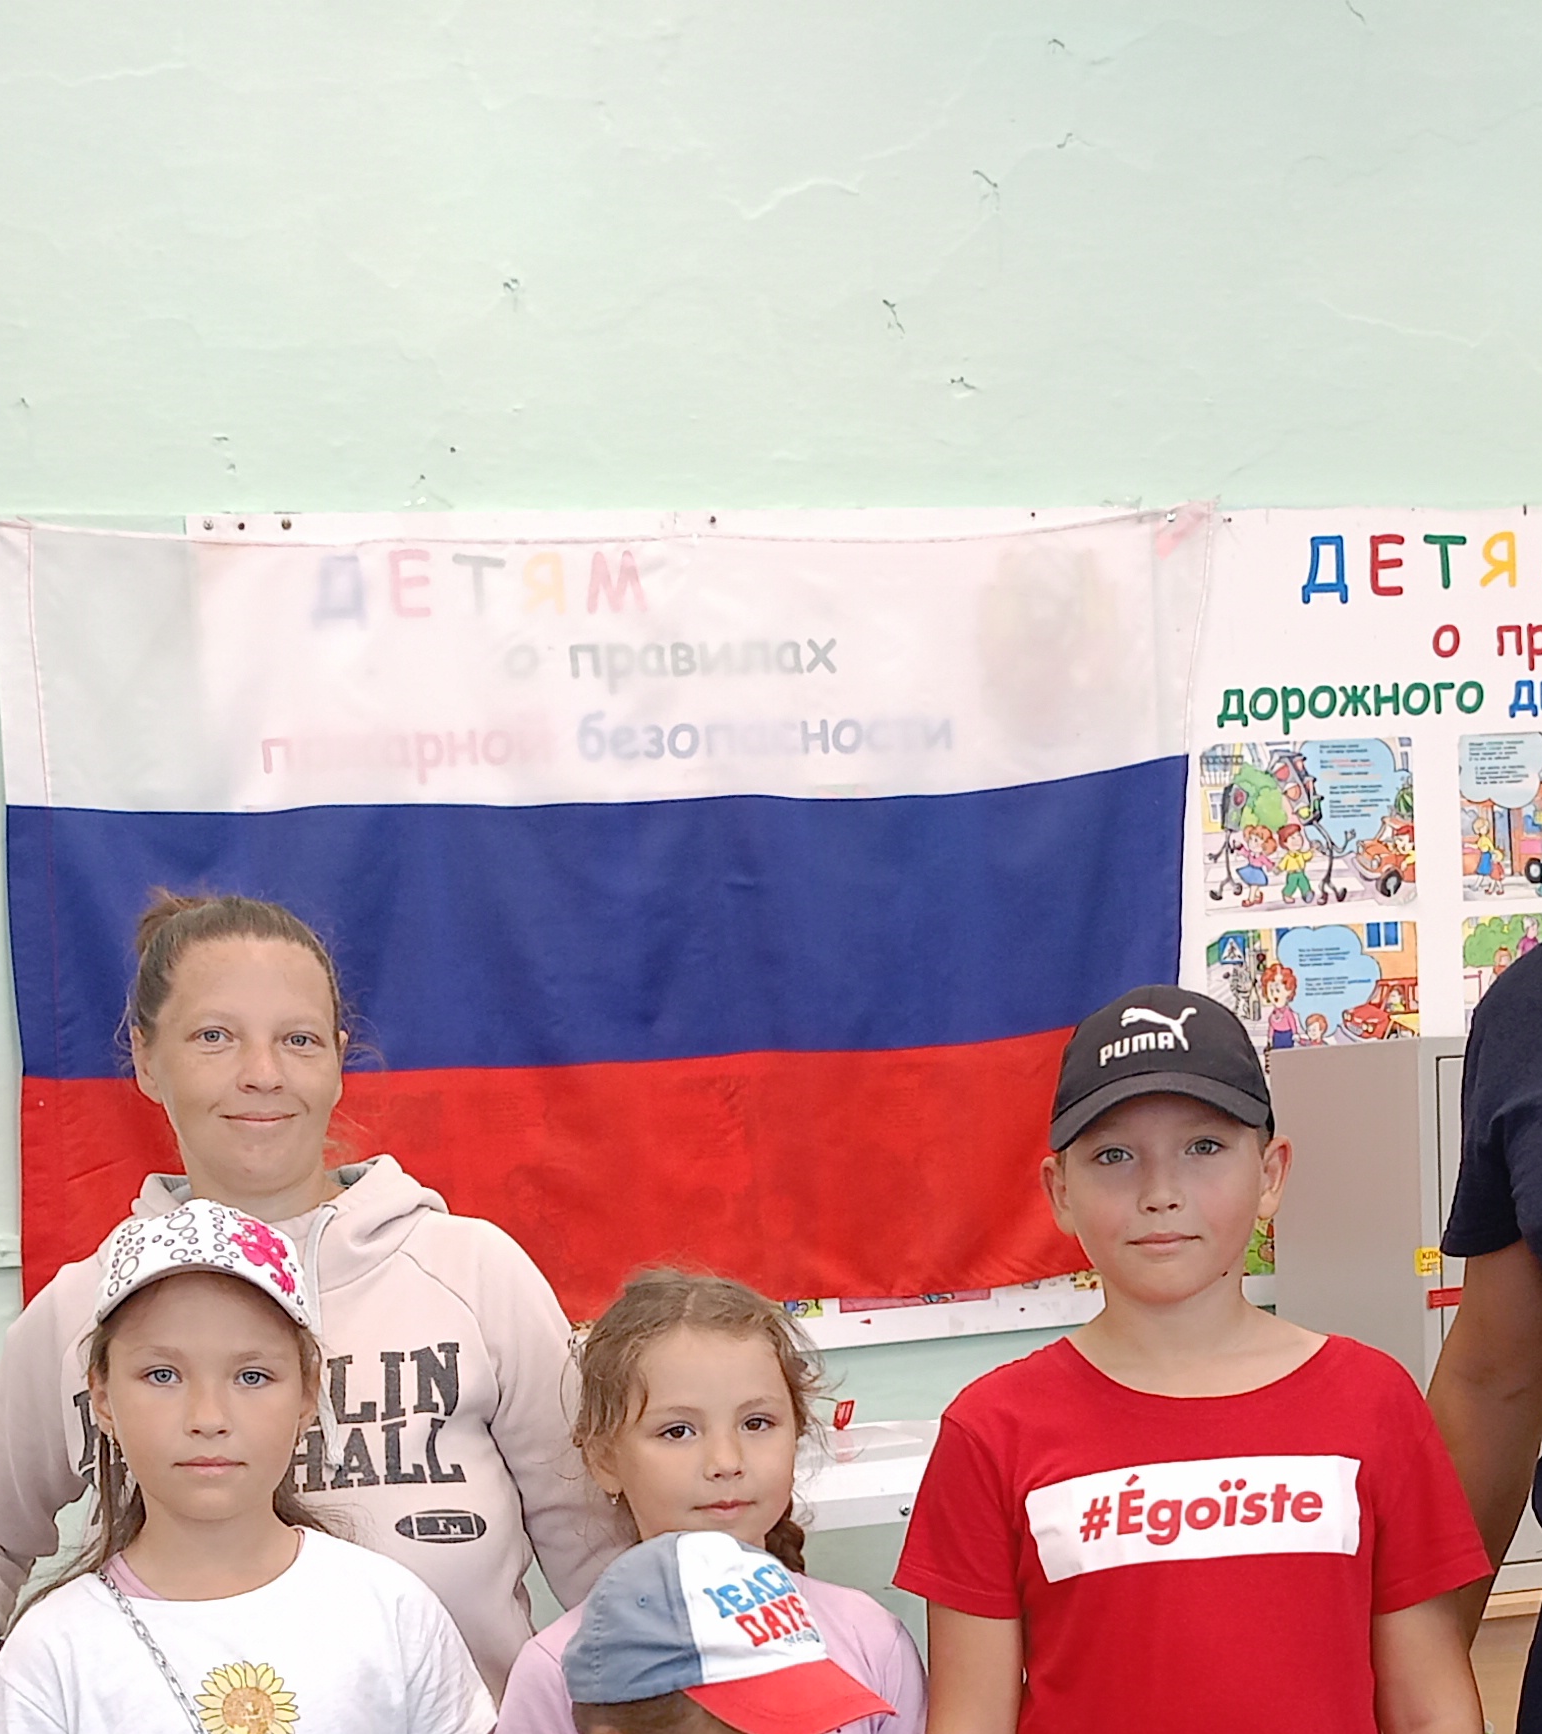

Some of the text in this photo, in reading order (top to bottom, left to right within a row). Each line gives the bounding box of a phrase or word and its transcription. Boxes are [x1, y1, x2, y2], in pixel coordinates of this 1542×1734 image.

[311, 549, 649, 629] ДЕТЯМ
[569, 638, 838, 694] правилах
[1433, 624, 1460, 658] о
[1217, 680, 1484, 735] дорожного
[1099, 1032, 1175, 1067] PUMA
[1080, 1473, 1323, 1546] #Égoïste
